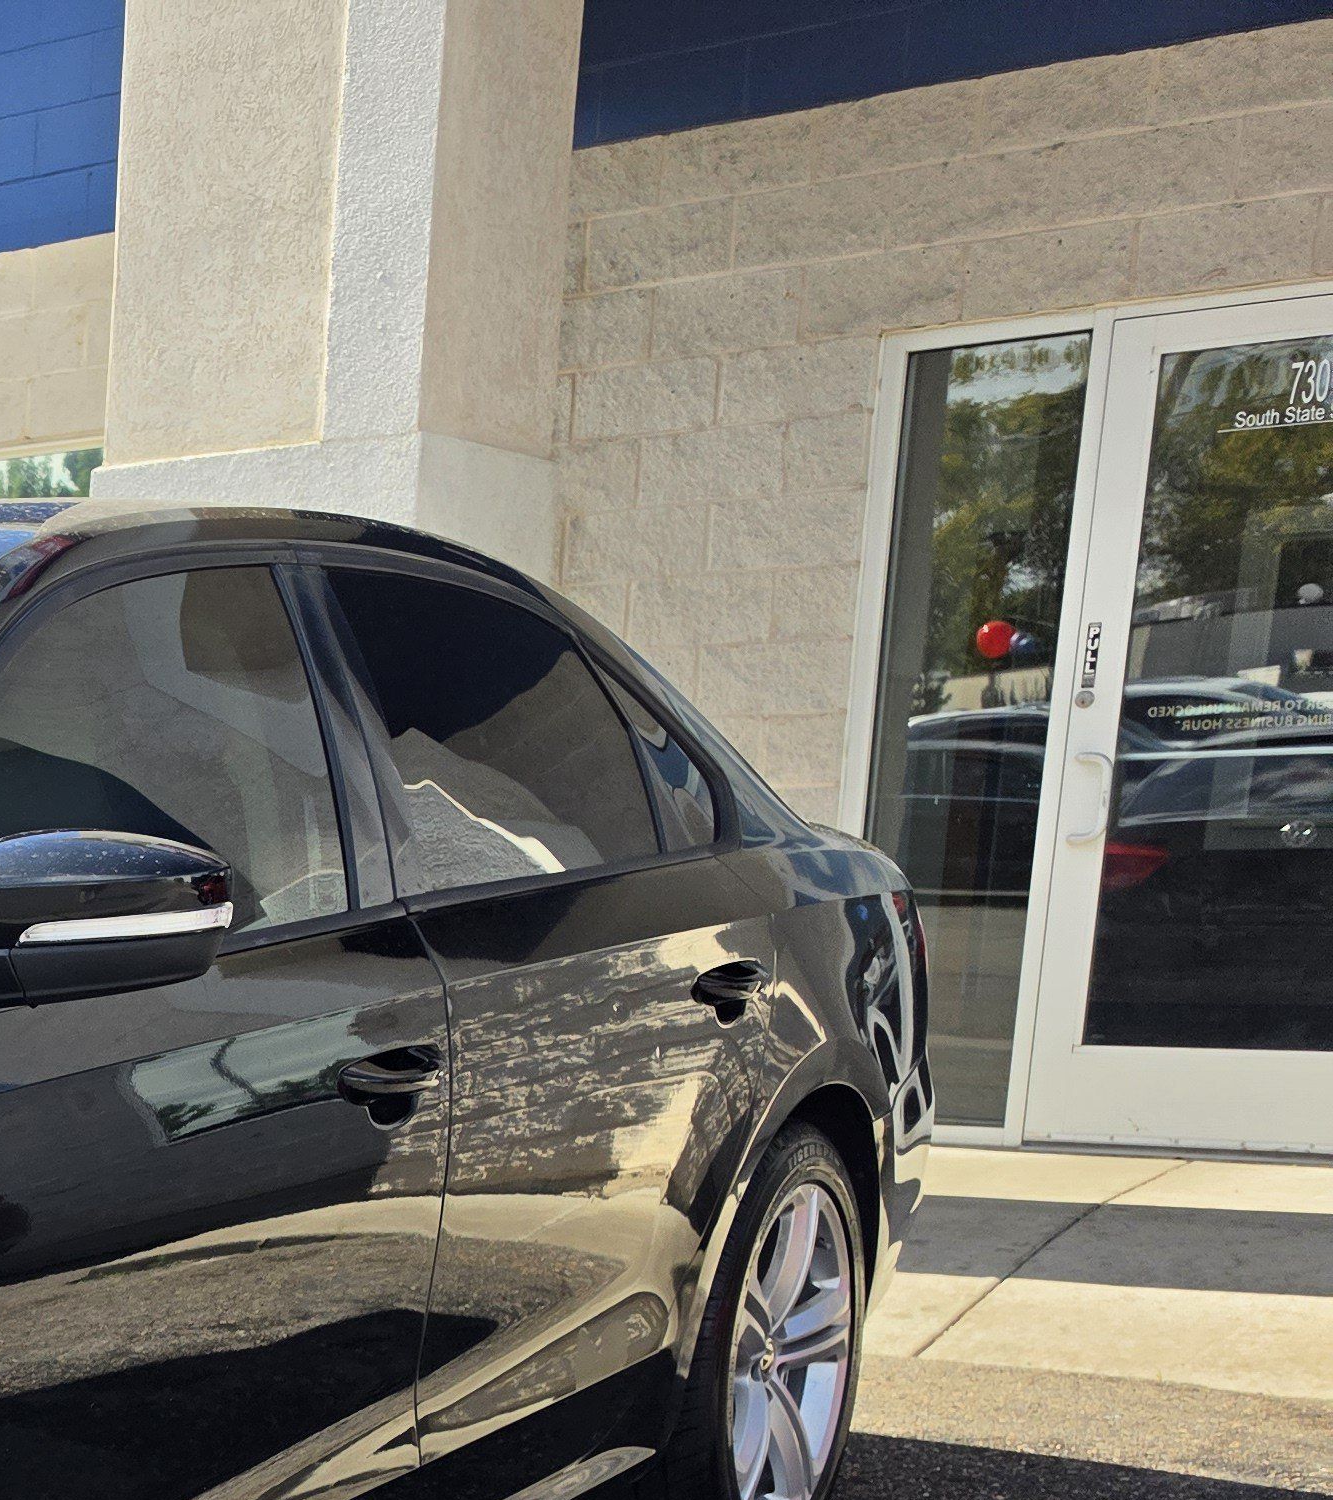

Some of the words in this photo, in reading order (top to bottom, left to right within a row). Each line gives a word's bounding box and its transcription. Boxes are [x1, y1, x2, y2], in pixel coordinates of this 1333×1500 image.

[1289, 359, 1331, 405] 730
[1234, 408, 1280, 428] South
[1284, 405, 1325, 423] State
[1084, 626, 1100, 675] PULL
